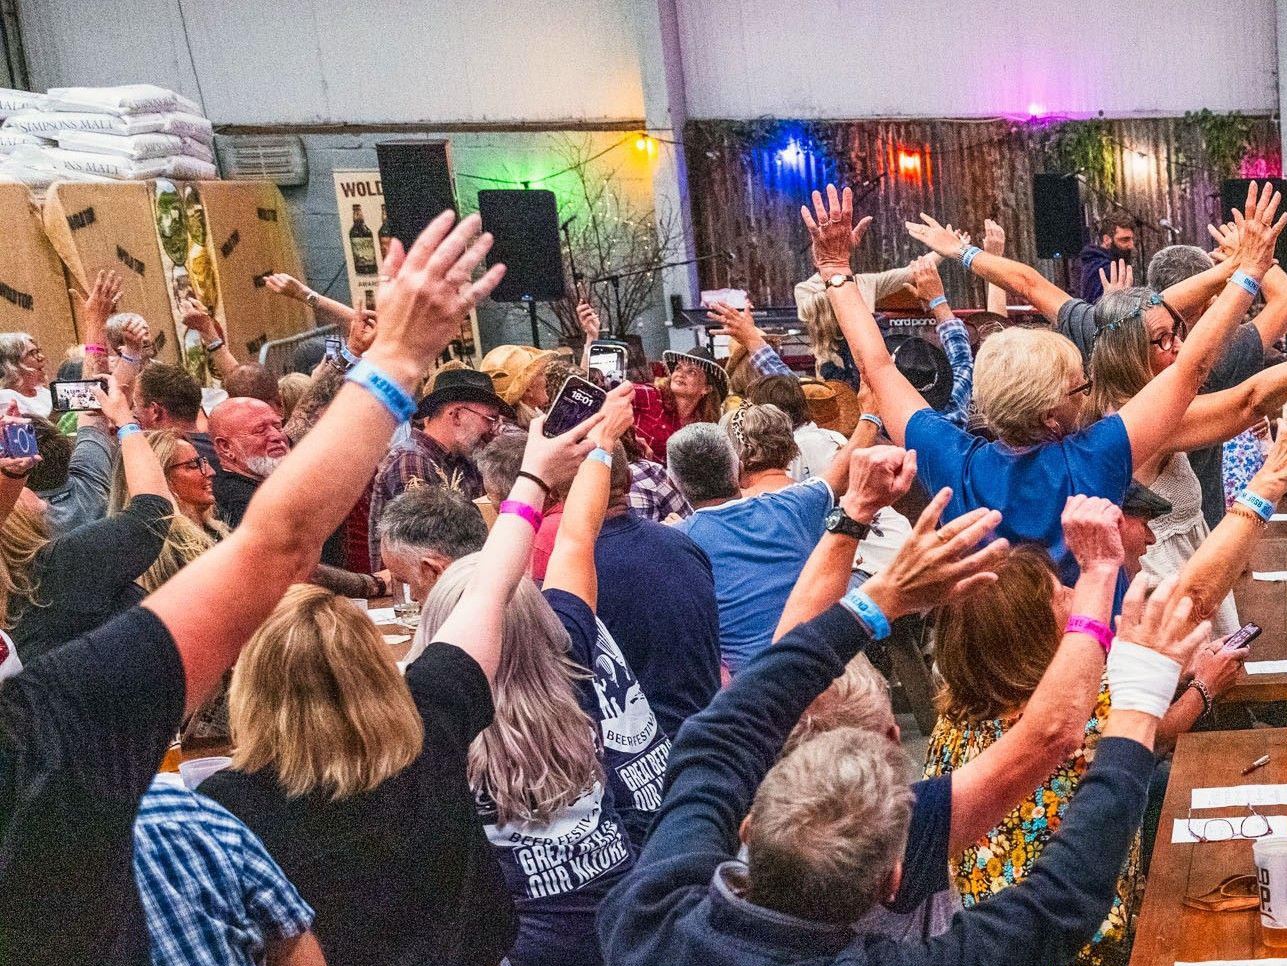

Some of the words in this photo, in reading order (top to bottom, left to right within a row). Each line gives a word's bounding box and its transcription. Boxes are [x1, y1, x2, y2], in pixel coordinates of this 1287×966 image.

[20, 120, 76, 134] SIMPSONS
[79, 119, 113, 131] MALT
[889, 317, 912, 327] nord
[911, 317, 937, 330] piano
[571, 390, 594, 407] 18:01
[606, 729, 633, 747] BEER
[620, 755, 657, 792] GREAT
[633, 783, 662, 812] OUR
[518, 844, 575, 877] GREAT
[528, 865, 574, 899] OUR
[569, 838, 627, 883] NATURE
